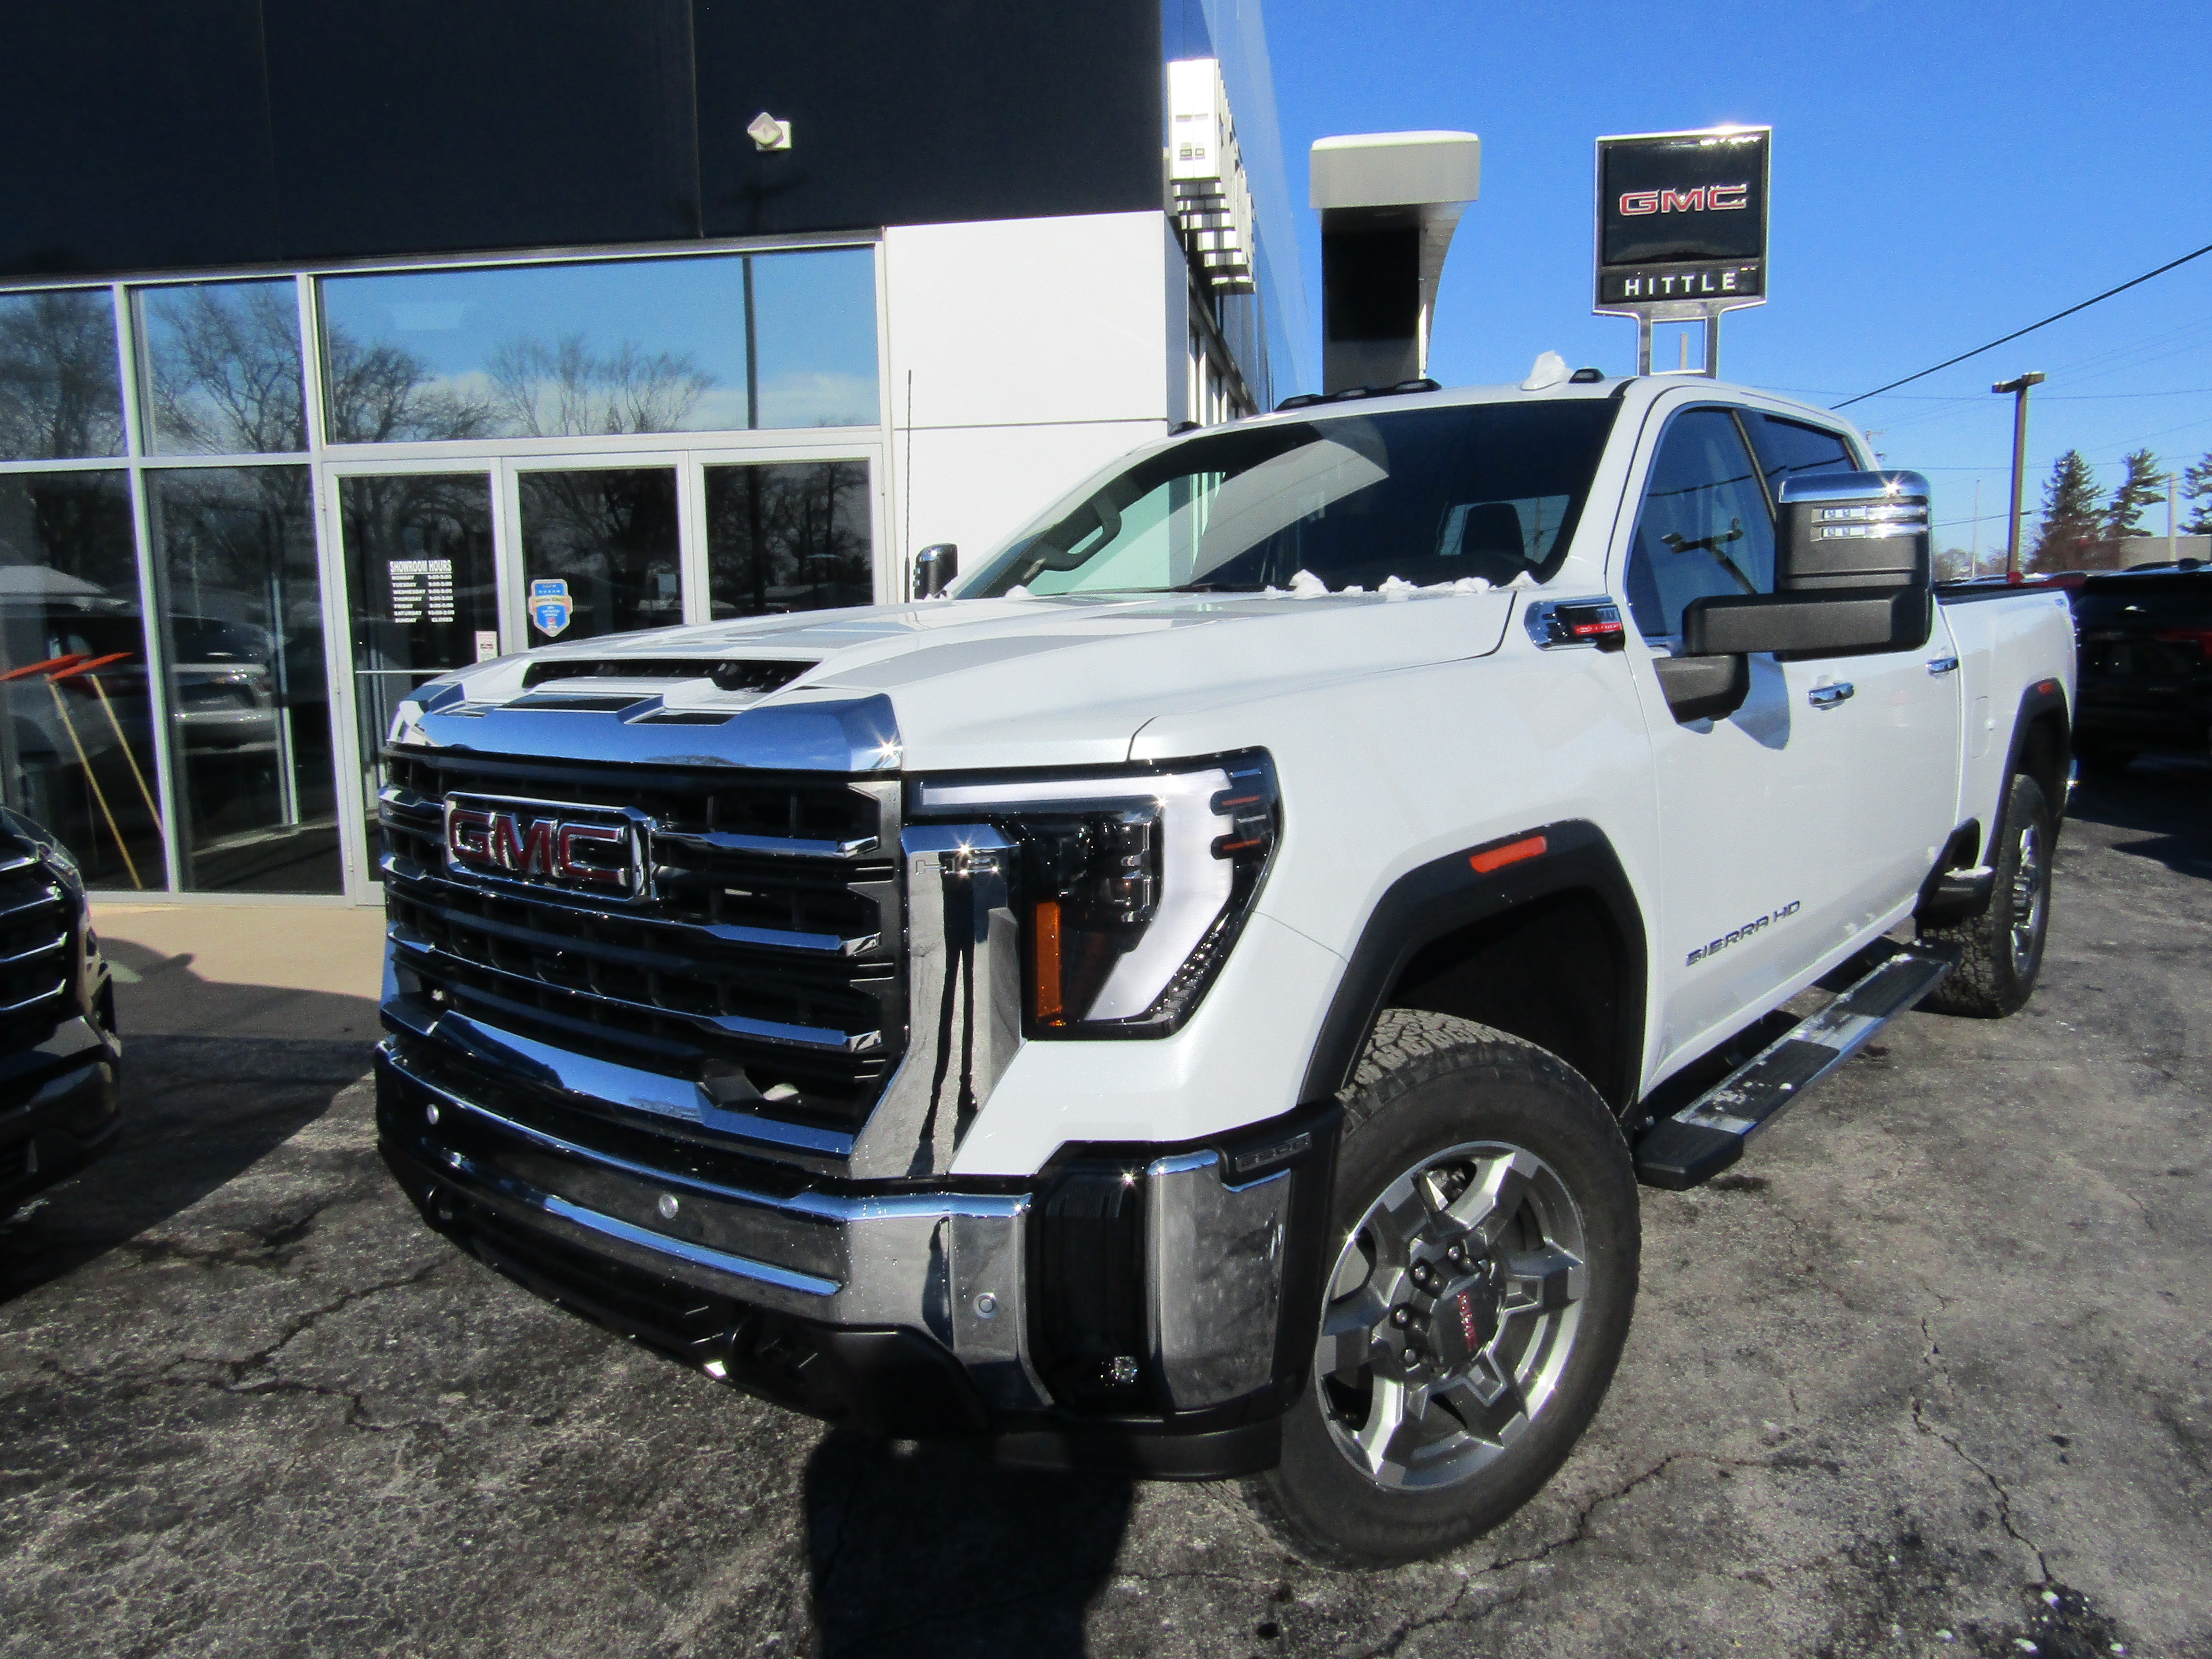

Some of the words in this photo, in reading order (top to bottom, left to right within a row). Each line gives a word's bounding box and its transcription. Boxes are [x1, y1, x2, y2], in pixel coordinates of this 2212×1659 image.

[1619, 183, 1748, 216] GMC
[1624, 272, 1737, 296] HITTLE
[390, 560, 428, 573] SHOWROOM
[428, 559, 452, 572] HOURS
[450, 809, 627, 887] GMC
[1686, 915, 1769, 966] SIERRA
[1772, 899, 1800, 923] HD
